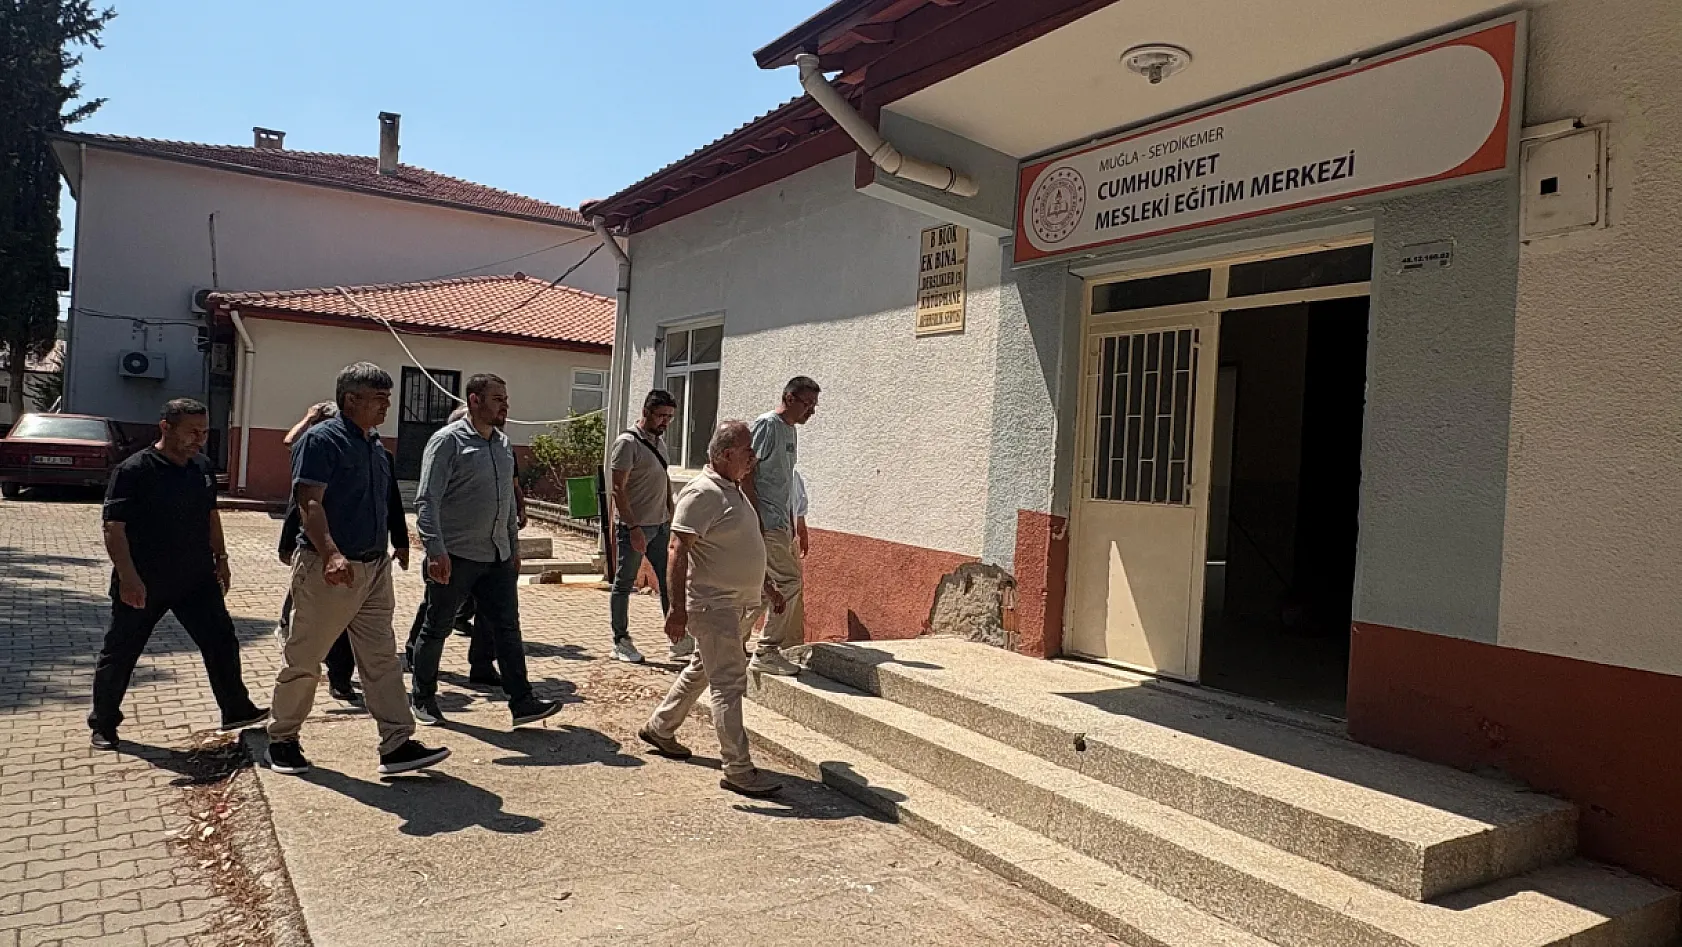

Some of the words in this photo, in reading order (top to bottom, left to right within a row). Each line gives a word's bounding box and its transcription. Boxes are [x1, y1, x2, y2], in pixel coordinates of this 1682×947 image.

[1099, 151, 1139, 172] MUĞLA
[1148, 126, 1224, 159] SEYDİKEMER
[1095, 192, 1169, 231] MESLEKİ
[1174, 180, 1245, 215] EĞİTİM
[1250, 149, 1356, 198] MERKEZİ
[1097, 153, 1220, 201] CUMHURİYET
[921, 253, 933, 273] EK
